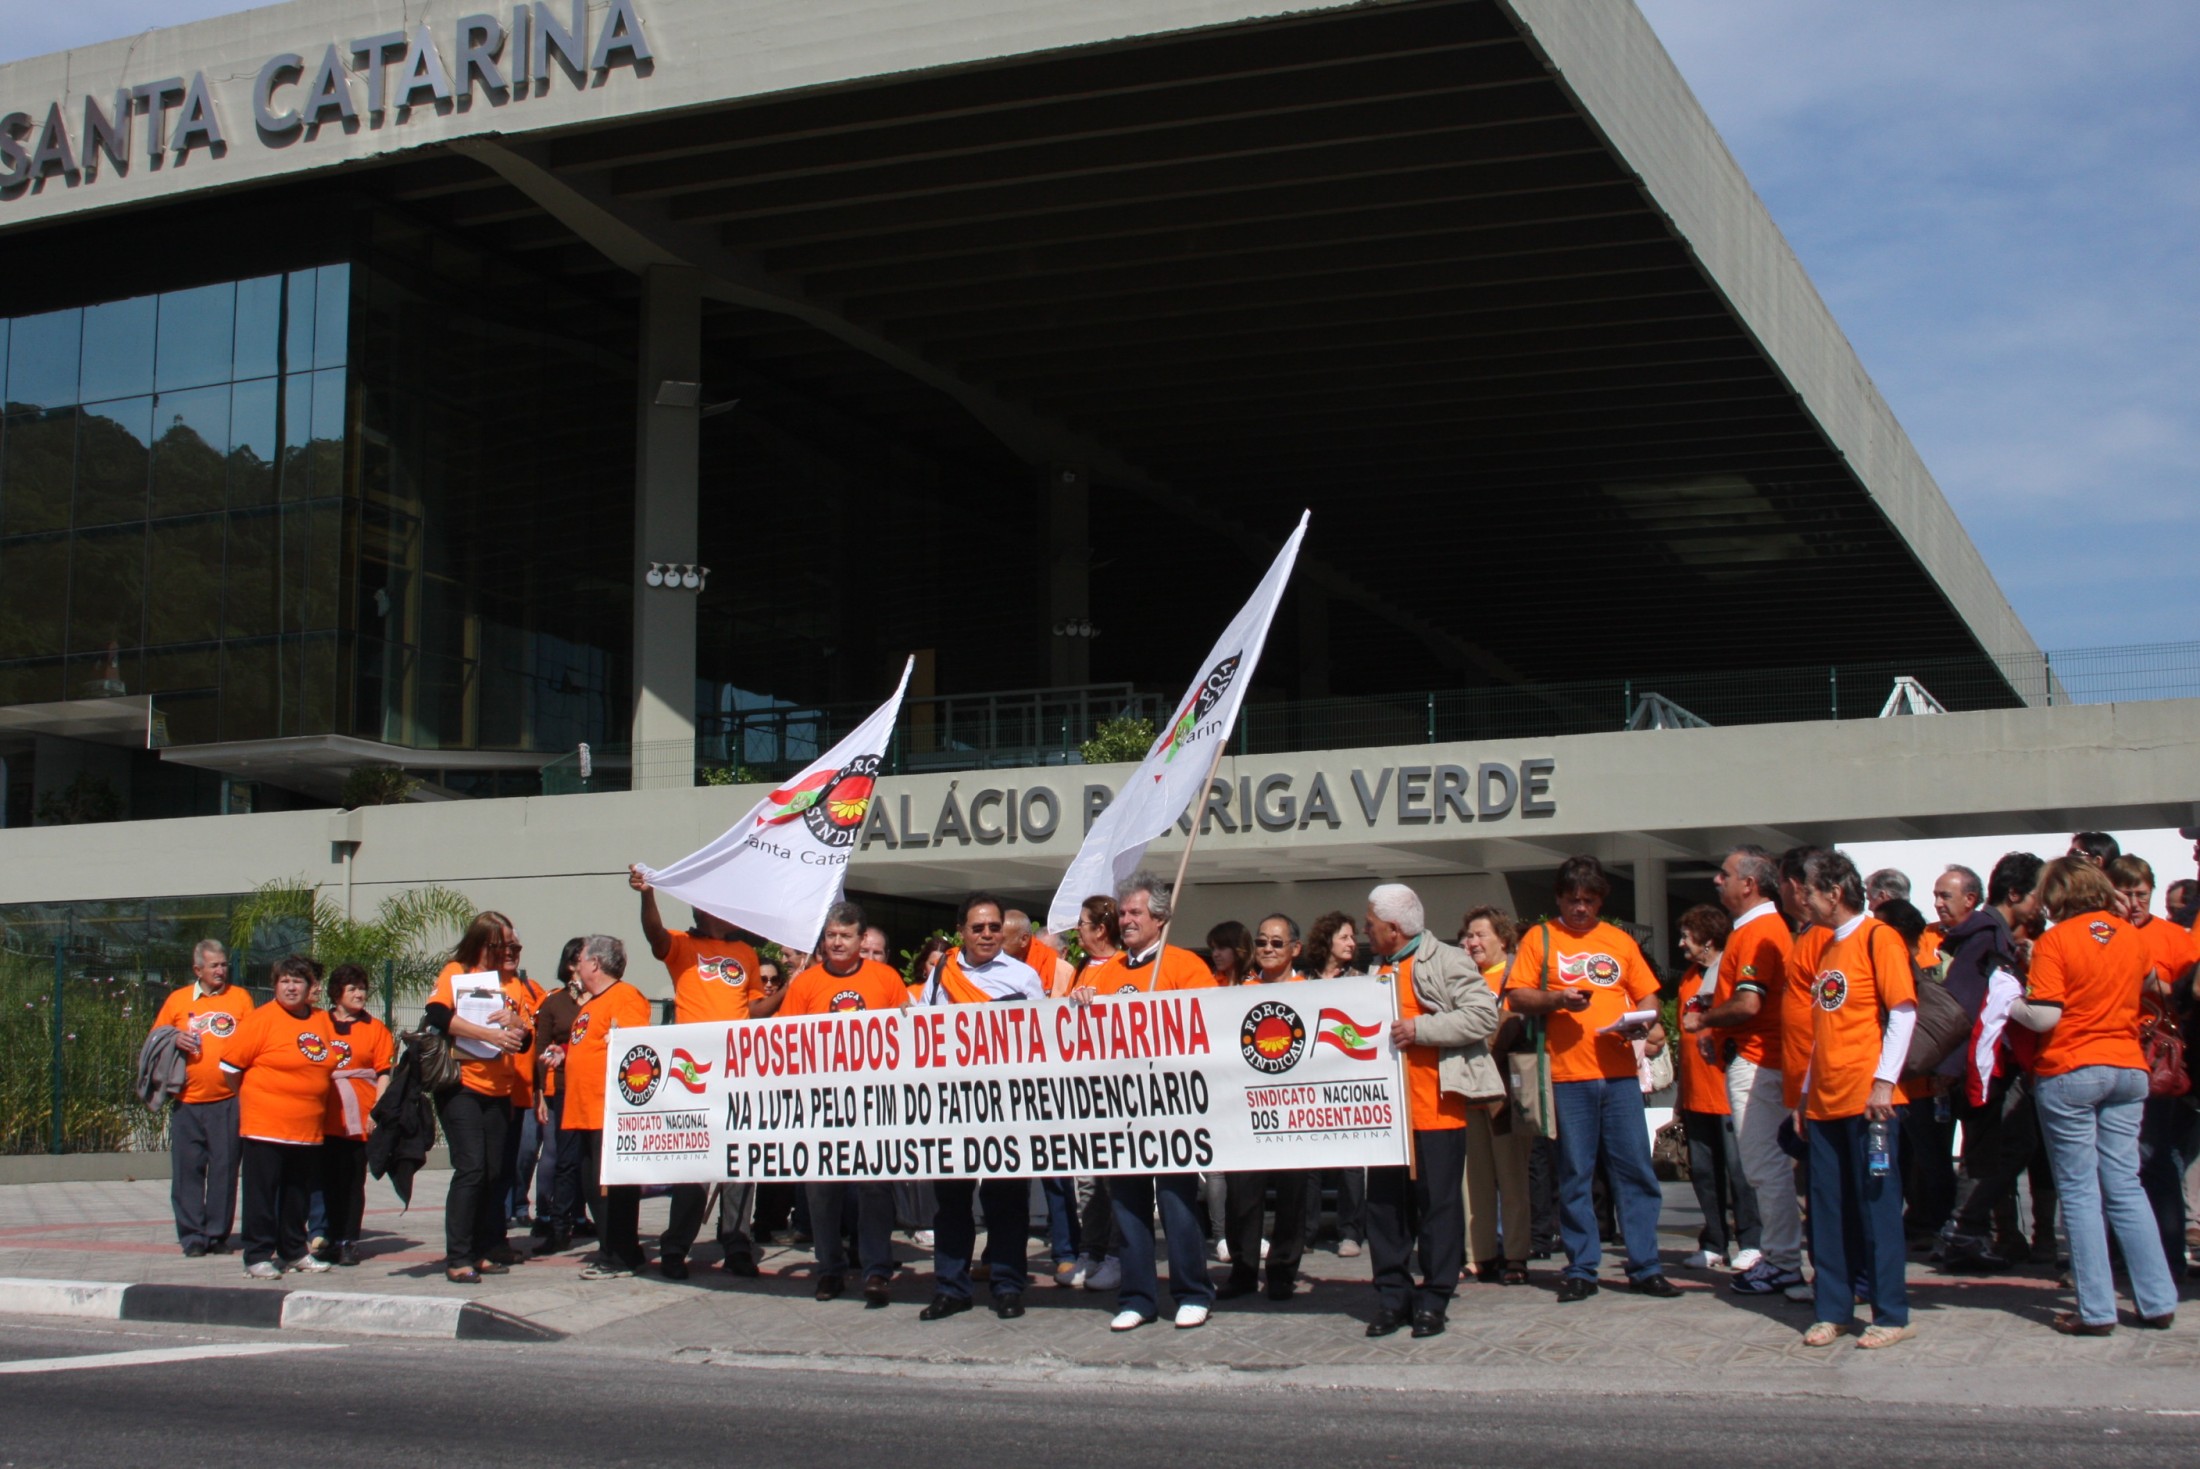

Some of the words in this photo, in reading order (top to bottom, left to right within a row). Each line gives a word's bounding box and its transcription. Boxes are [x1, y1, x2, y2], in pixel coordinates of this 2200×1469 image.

[0, 71, 227, 192] SANTA
[254, 0, 655, 140] CATARINA
[1351, 758, 1557, 826] VERDE
[800, 850, 850, 866] Cata
[1244, 1003, 1296, 1033] FORÇA
[724, 1015, 900, 1078] APOSENTADOS
[913, 1013, 947, 1069] DE
[955, 1007, 1048, 1067] SANTA
[1055, 997, 1210, 1063] CATARINA
[621, 1046, 658, 1070] FORÇA
[1243, 1039, 1304, 1072] SINDICAL
[619, 1078, 660, 1104] SINDICAL
[726, 1091, 752, 1131] NA
[758, 1088, 804, 1130] LUTA
[811, 1085, 857, 1128] PELO
[863, 1083, 897, 1127] FIM
[903, 1082, 932, 1126] DO
[938, 1079, 1004, 1125] FATOR
[1008, 1061, 1209, 1122] PREVIDENCIÁRIO
[1246, 1086, 1316, 1108] SINDICATO
[1323, 1083, 1389, 1104] NACIONAL
[617, 1115, 662, 1132] SINDICATO
[665, 1112, 708, 1130] NACIONAL
[1250, 1109, 1280, 1130] DOS
[1288, 1104, 1392, 1129] APOSENTADOS
[616, 1134, 637, 1151] DOS
[642, 1131, 710, 1151] APOSENTADOS
[726, 1143, 740, 1178] E
[749, 1141, 809, 1178] PELO
[818, 1137, 954, 1176] REAJUSTE
[963, 1135, 1021, 1174] DOS
[1030, 1121, 1214, 1172] BENEFÍCIOS
[1256, 1134, 1303, 1144] SANTA
[1310, 1130, 1391, 1142] CATARINA
[617, 1154, 651, 1163] SANTA
[655, 1153, 708, 1161] CATARINA
